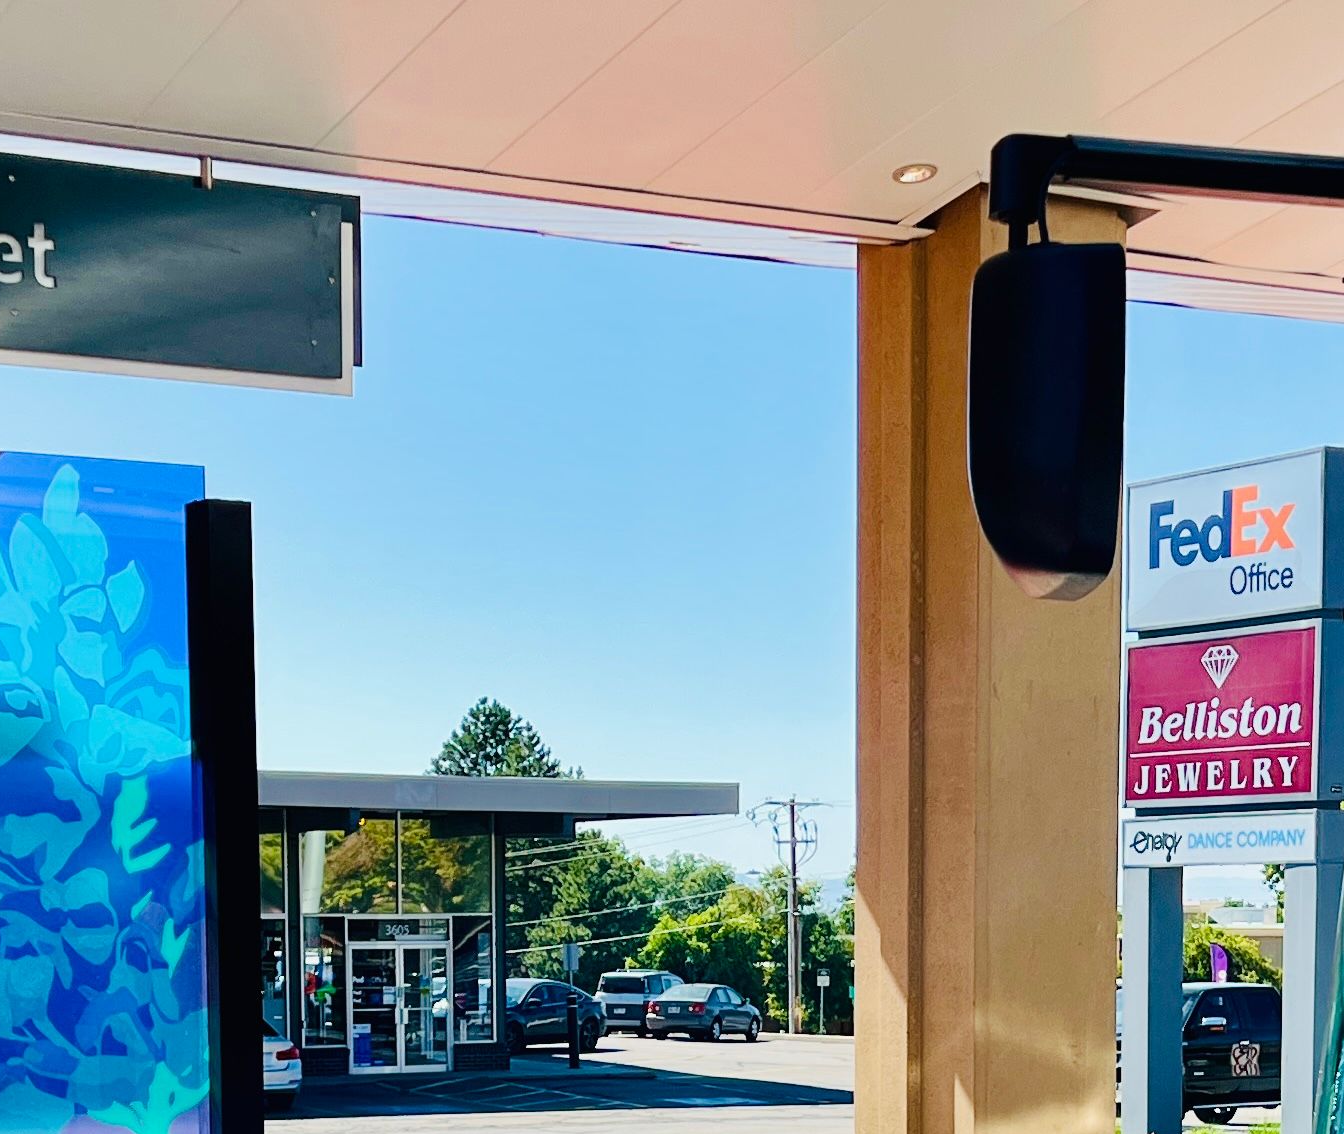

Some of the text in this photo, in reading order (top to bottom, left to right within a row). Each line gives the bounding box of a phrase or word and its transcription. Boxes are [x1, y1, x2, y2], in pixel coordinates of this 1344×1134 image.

[1148, 484, 1297, 570] FedEx
[1229, 562, 1294, 595] Office
[1137, 696, 1303, 746] Belliston
[1132, 755, 1300, 795] JEWELRY
[1187, 830, 1232, 849] DANCE
[1236, 828, 1306, 848] COMPANY
[385, 924, 410, 936] 3605
